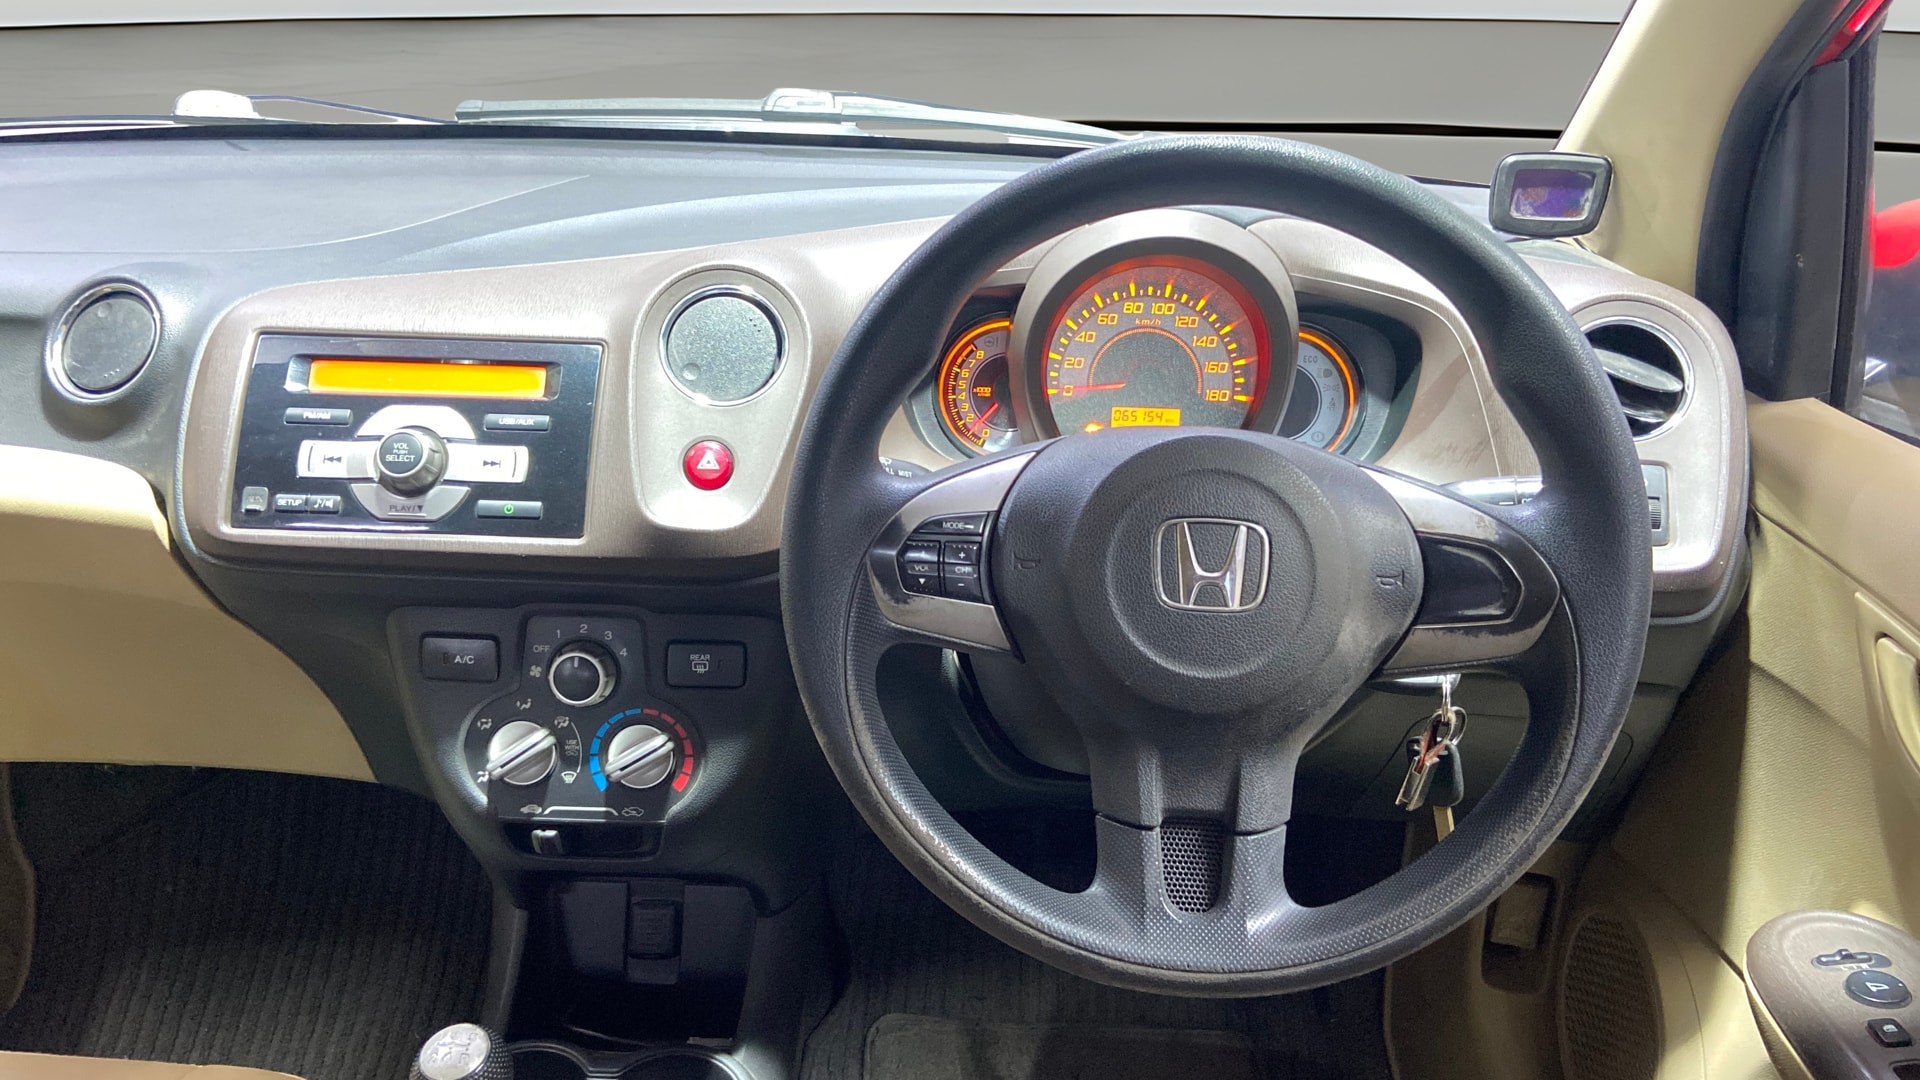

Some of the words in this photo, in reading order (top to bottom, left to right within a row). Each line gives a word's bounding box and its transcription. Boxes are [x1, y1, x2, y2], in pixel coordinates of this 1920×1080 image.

[1123, 302, 1144, 314] 80
[1151, 303, 1175, 315] 100
[1097, 314, 1118, 325] 60
[1135, 318, 1161, 326] km/h
[1175, 316, 1199, 328] 120
[1075, 332, 1096, 343] 40
[1192, 335, 1218, 348] 140
[976, 350, 984, 359] 8
[969, 359, 976, 368] 7
[1063, 357, 1085, 369] 20
[1303, 355, 1318, 364] ECO
[1204, 361, 1229, 374] 160
[961, 369, 970, 378] 6
[958, 380, 967, 390] 5
[958, 391, 966, 400] 4
[1205, 390, 1230, 402] 180
[961, 403, 969, 412] 3
[498, 417, 535, 426] USB/AUX
[966, 413, 975, 422] 2
[982, 428, 991, 438] 0
[393, 442, 409, 450] VOL
[385, 455, 416, 463] SELECT
[277, 499, 303, 507] SETUP
[942, 521, 965, 530] MODE
[579, 624, 588, 634] 2
[556, 629, 561, 639] 1
[604, 630, 613, 640] 3
[532, 645, 551, 653] OFF
[619, 647, 628, 657] 4
[454, 655, 475, 664] A/C
